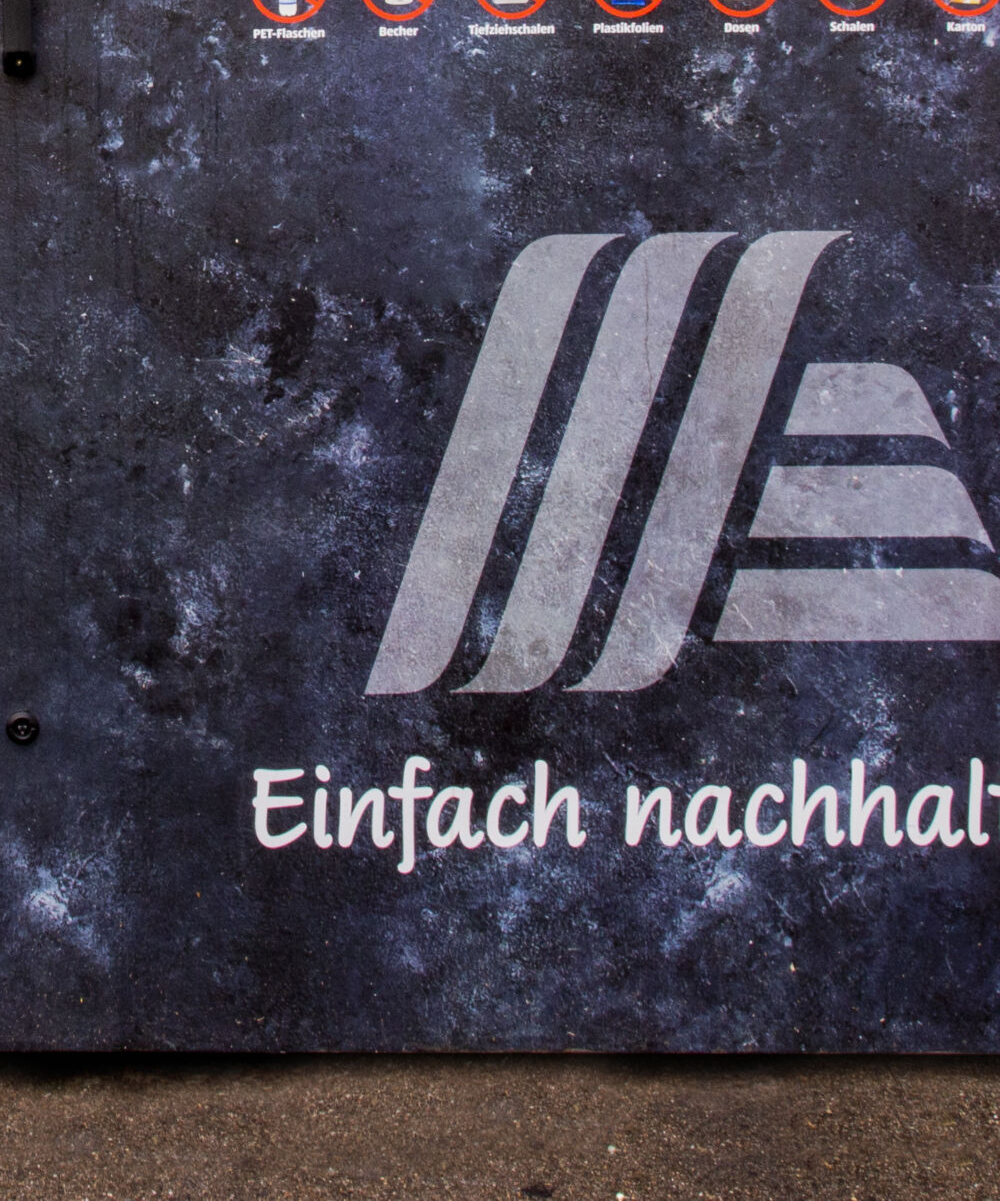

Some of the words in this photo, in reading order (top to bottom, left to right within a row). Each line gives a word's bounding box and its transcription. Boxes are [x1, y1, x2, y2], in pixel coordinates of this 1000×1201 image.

[379, 25, 419, 37] Becher
[468, 22, 556, 37] Tiefziehschalen
[593, 21, 664, 34] Plastikfolien
[724, 22, 760, 34] Dosen
[829, 20, 875, 33] Schalen
[946, 20, 986, 33] Karton
[252, 27, 326, 40] PET-Flaschen
[252, 754, 587, 874] Einfach
